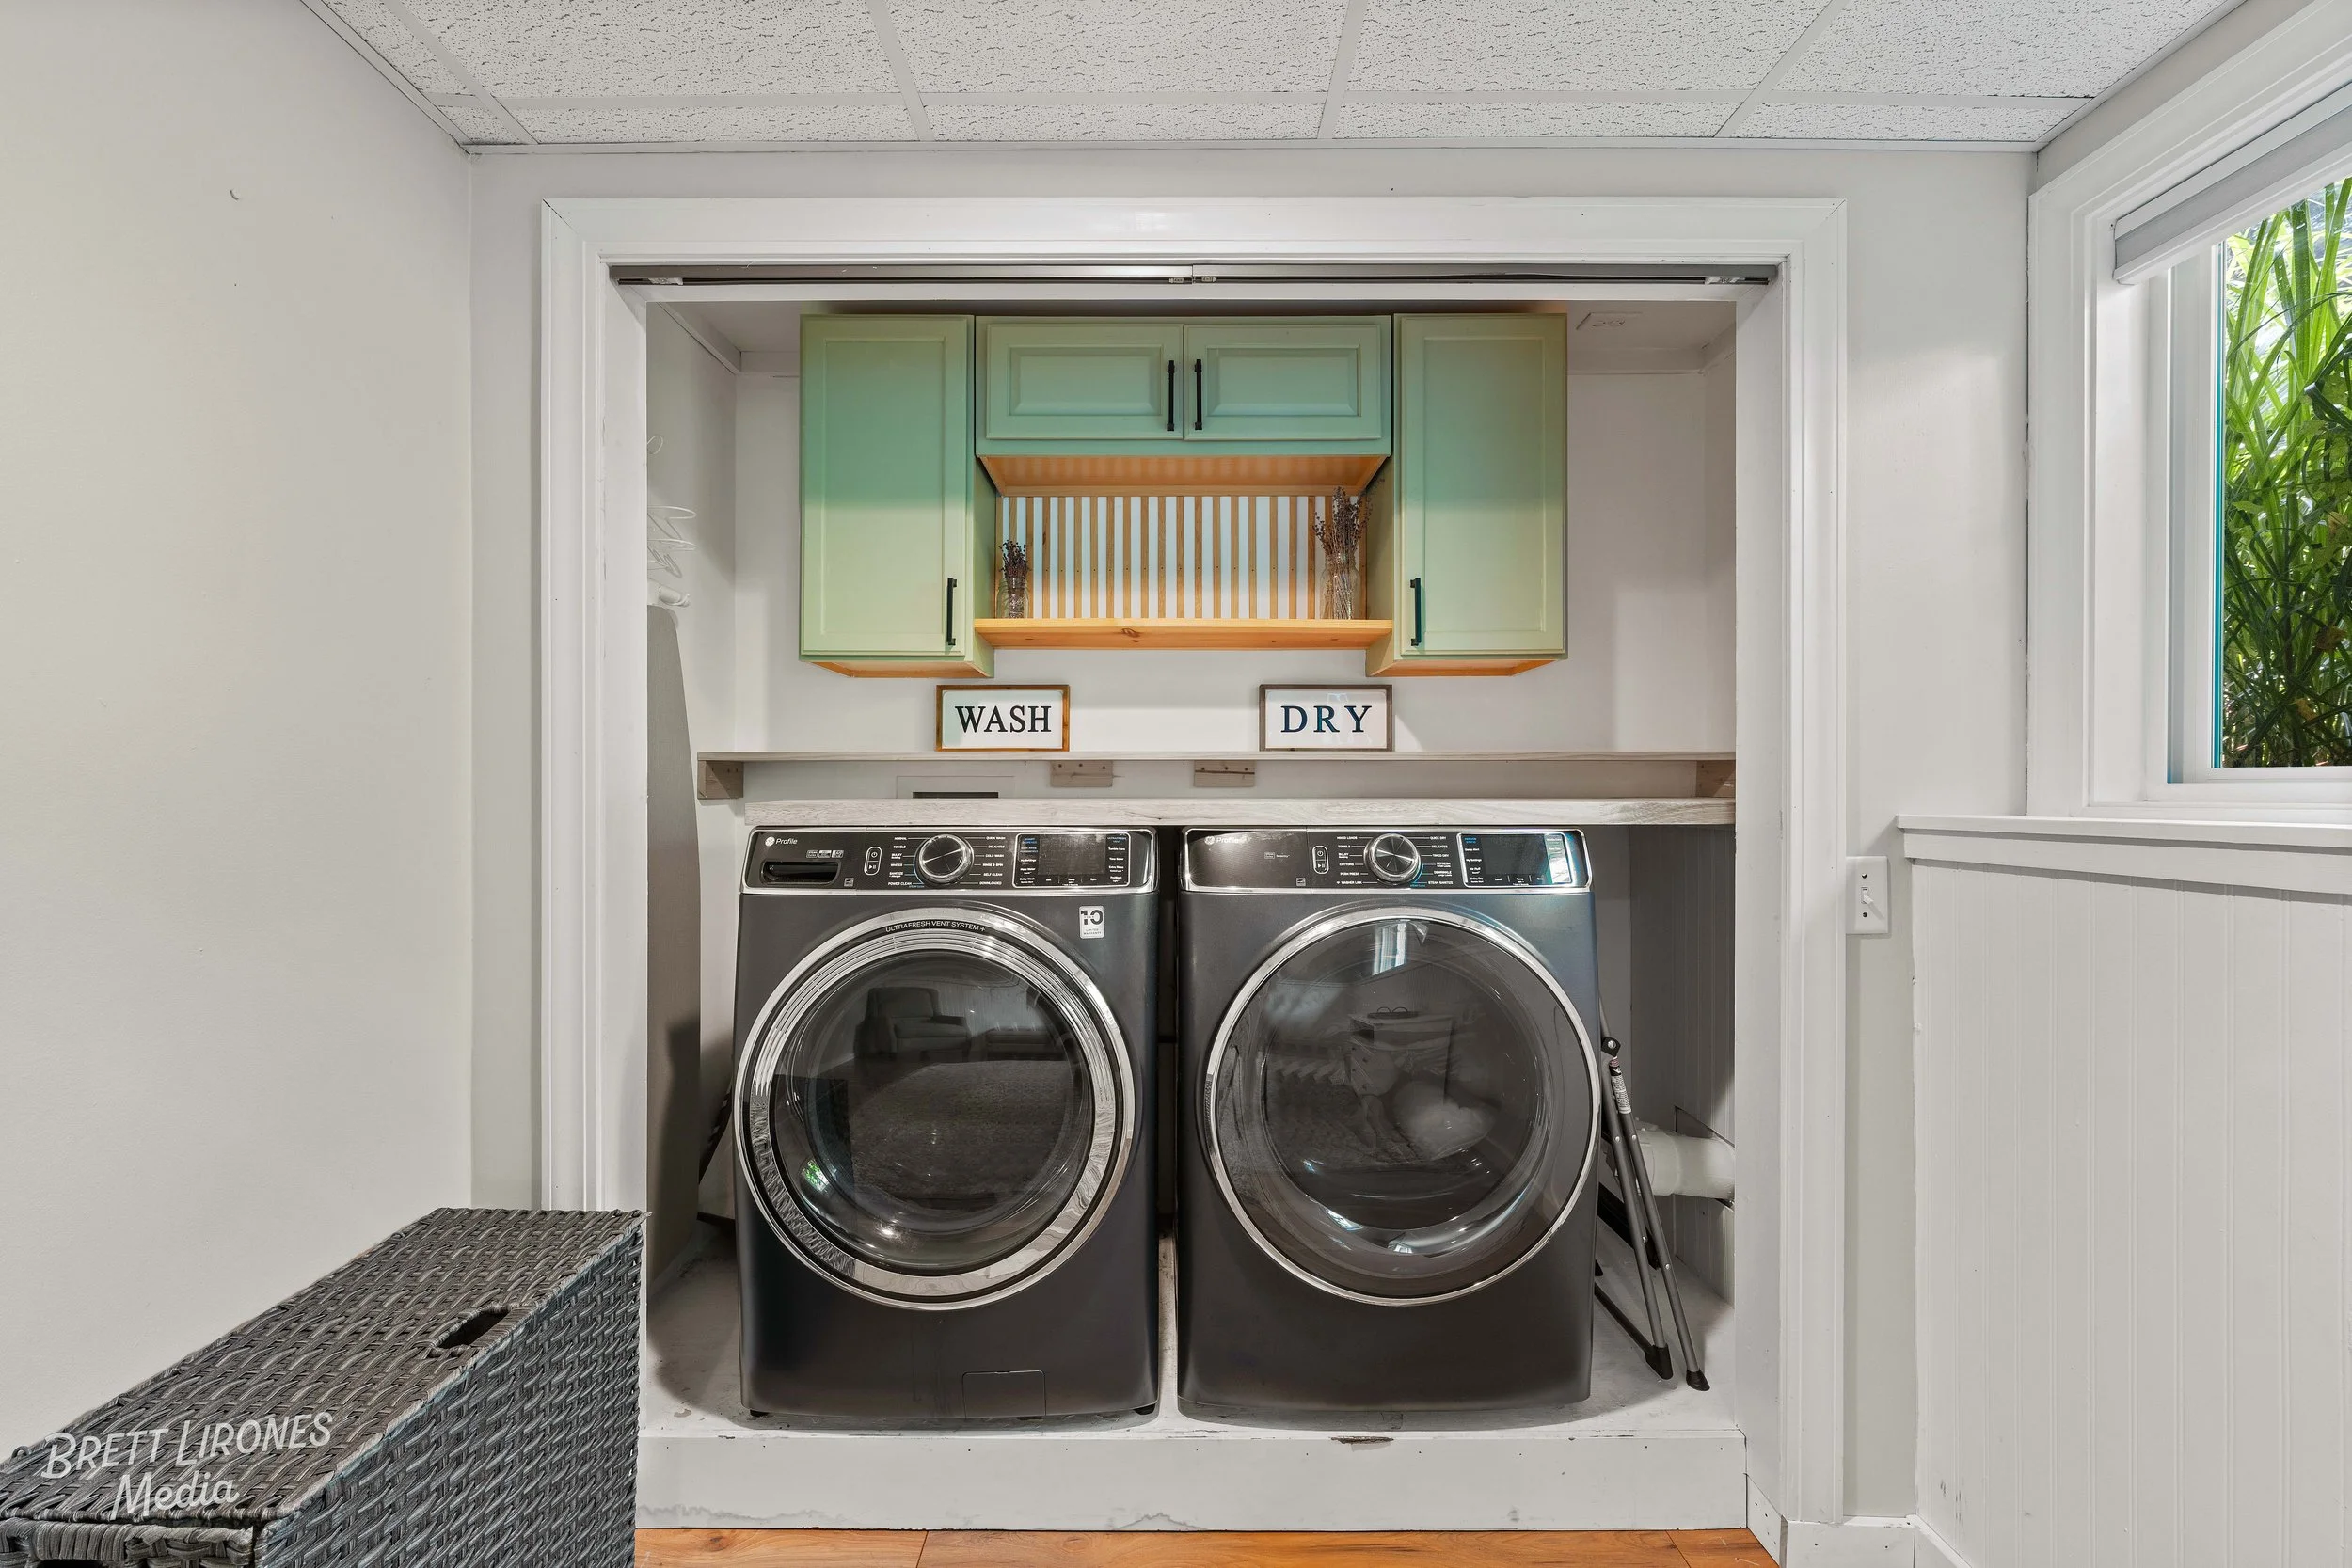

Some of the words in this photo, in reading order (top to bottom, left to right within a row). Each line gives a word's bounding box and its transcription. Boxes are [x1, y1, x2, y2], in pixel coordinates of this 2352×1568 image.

[955, 705, 1052, 733] WASH
[1280, 705, 1373, 733] DRY
[885, 920, 931, 933] ULTRAFRESH
[951, 921, 979, 931] SYSTEM
[1081, 910, 1103, 925] 10
